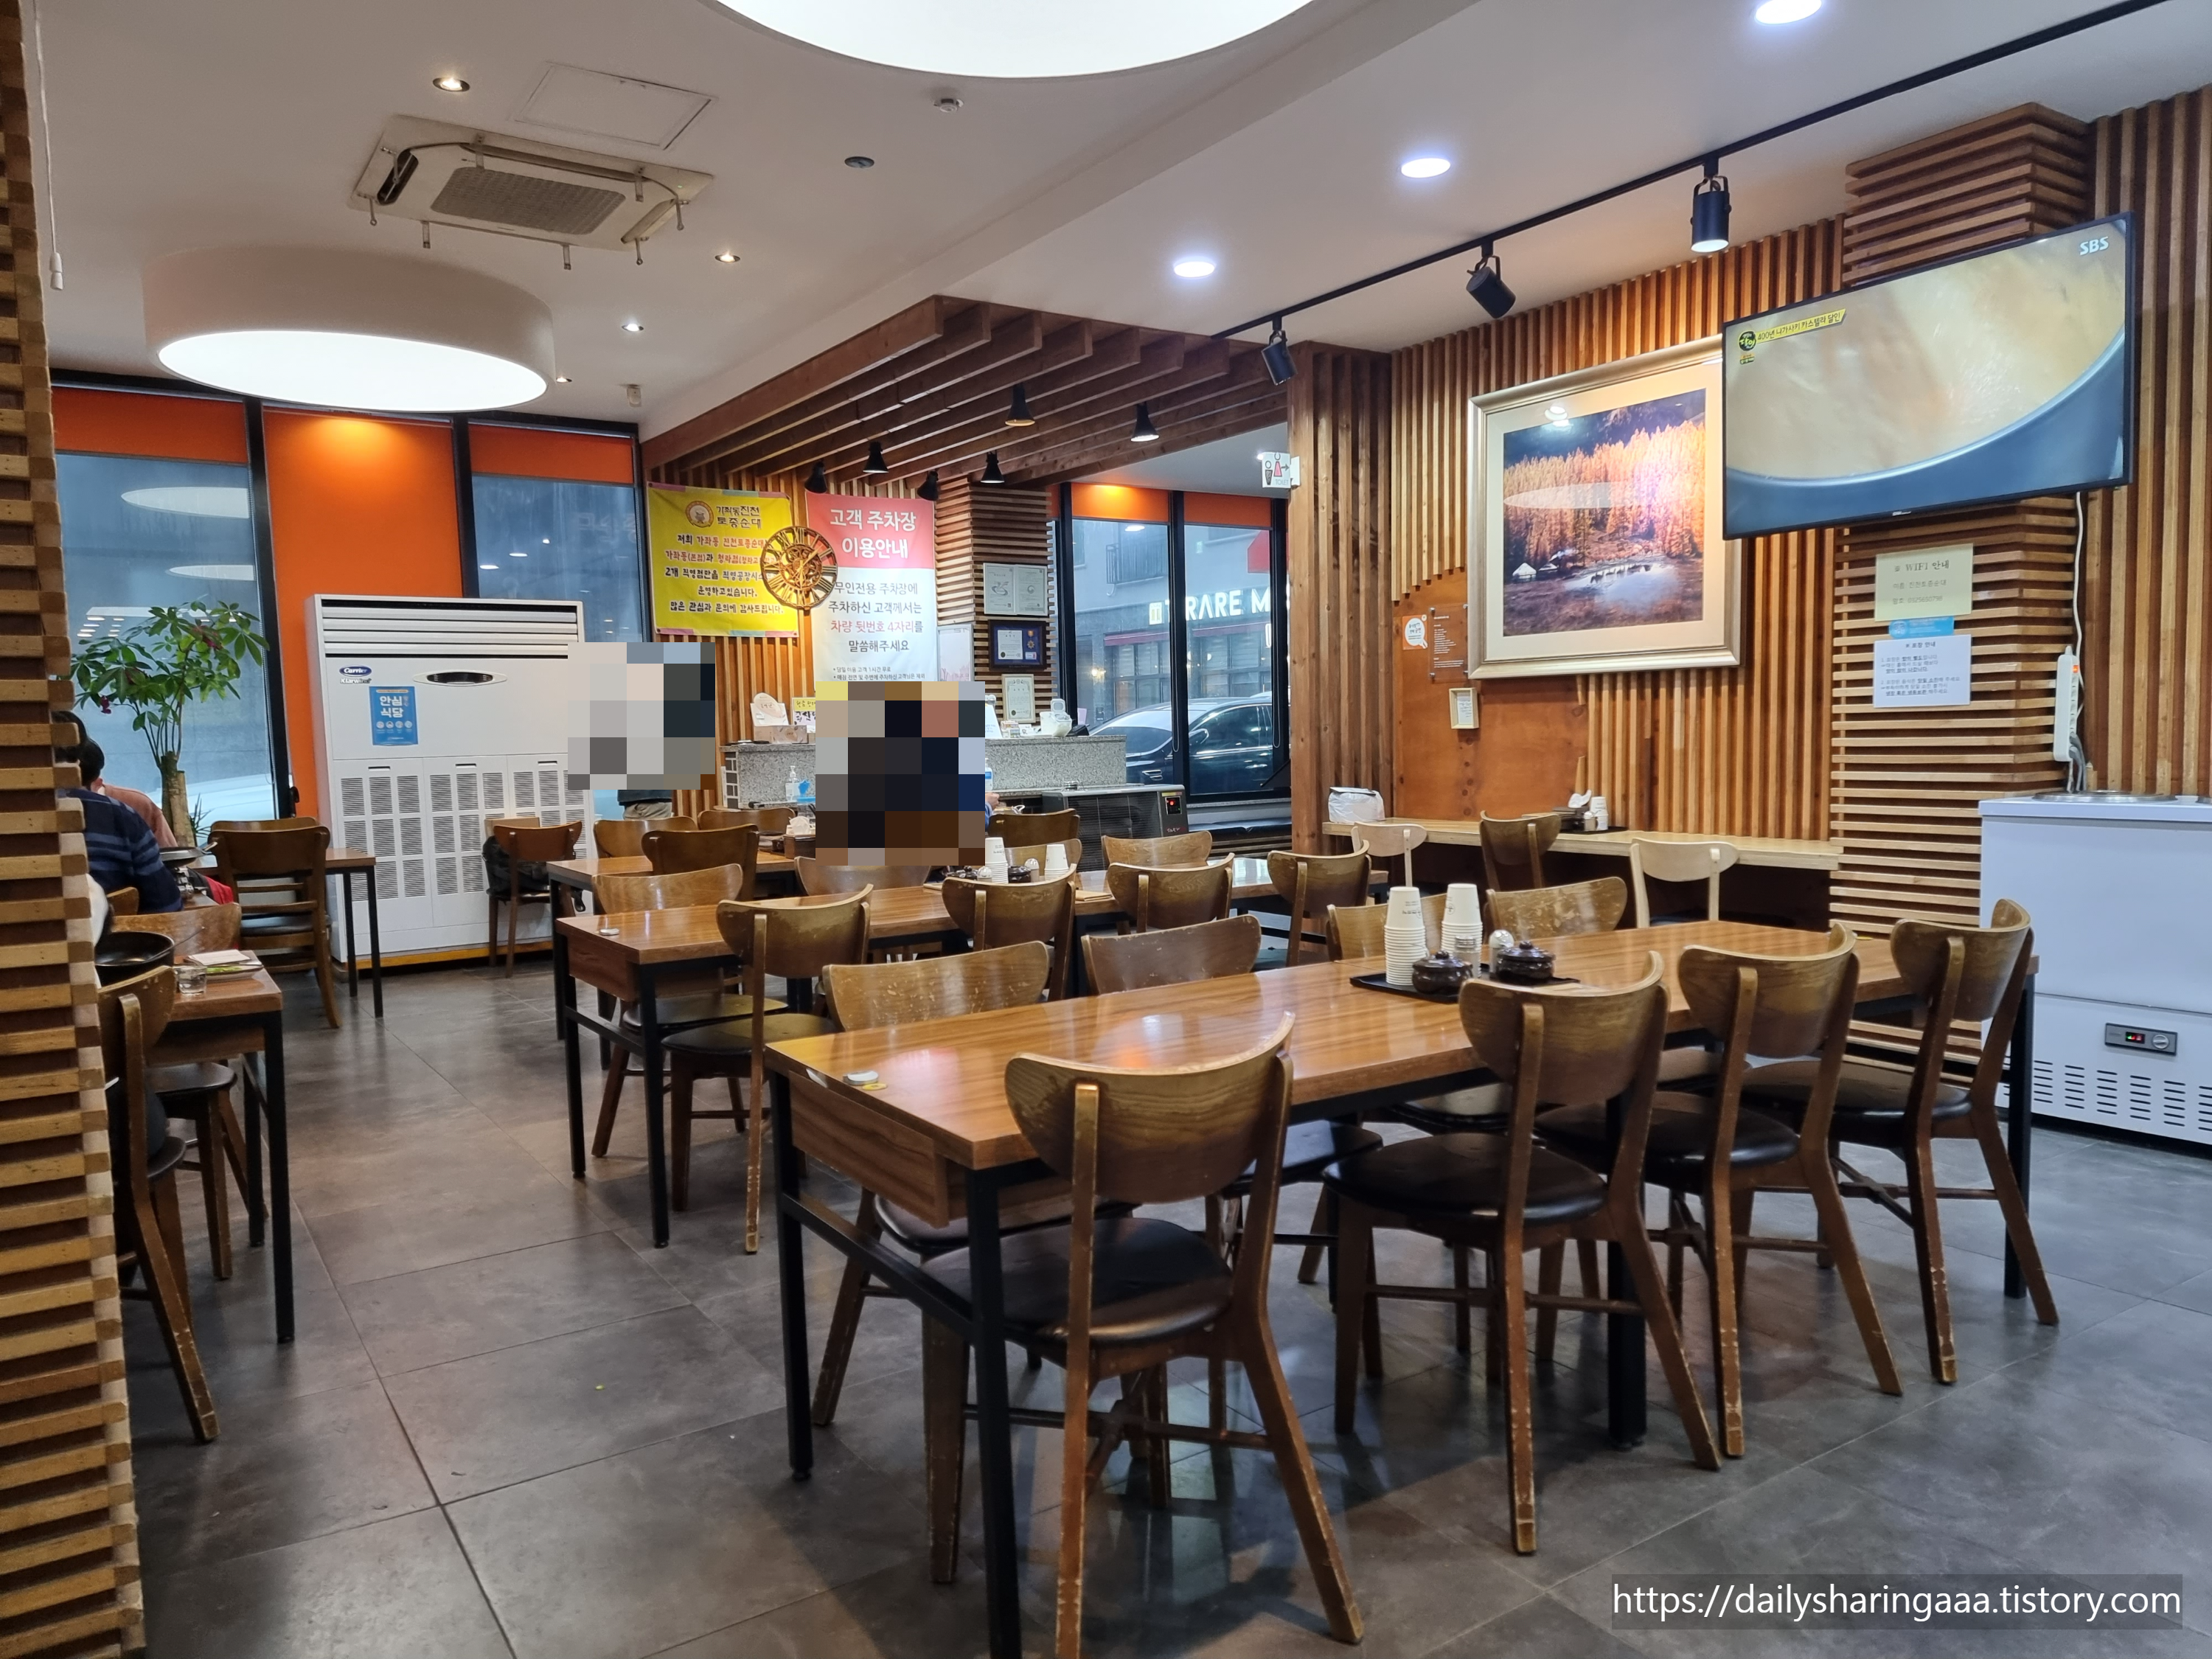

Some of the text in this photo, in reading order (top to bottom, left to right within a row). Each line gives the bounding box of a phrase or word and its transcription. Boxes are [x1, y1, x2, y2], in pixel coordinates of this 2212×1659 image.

[2080, 236, 2109, 255] SBS
[1776, 324, 1800, 335] 나가사키
[1802, 317, 1826, 329] 카스텔라
[1828, 312, 1840, 323] 달인
[717, 517, 762, 529] 토종순대
[830, 509, 917, 532] 고객 주차장
[677, 534, 767, 549] 저희 가좌동 진천토종순대
[841, 538, 908, 559] 이용안내
[665, 567, 679, 577] 2개
[1906, 560, 1950, 571] WIFI 안내
[834, 582, 918, 595] 무인전용 주차장에
[670, 601, 685, 611] 많은
[689, 602, 712, 612] 관심과
[715, 603, 737, 613] 문의에
[828, 601, 922, 614] 주차하신 고객께서는
[830, 620, 923, 633] 차량 뒷번호 4자리를
[849, 640, 909, 653] 말씀해주세요
[380, 696, 402, 706] 안심
[380, 708, 403, 718] 식당
